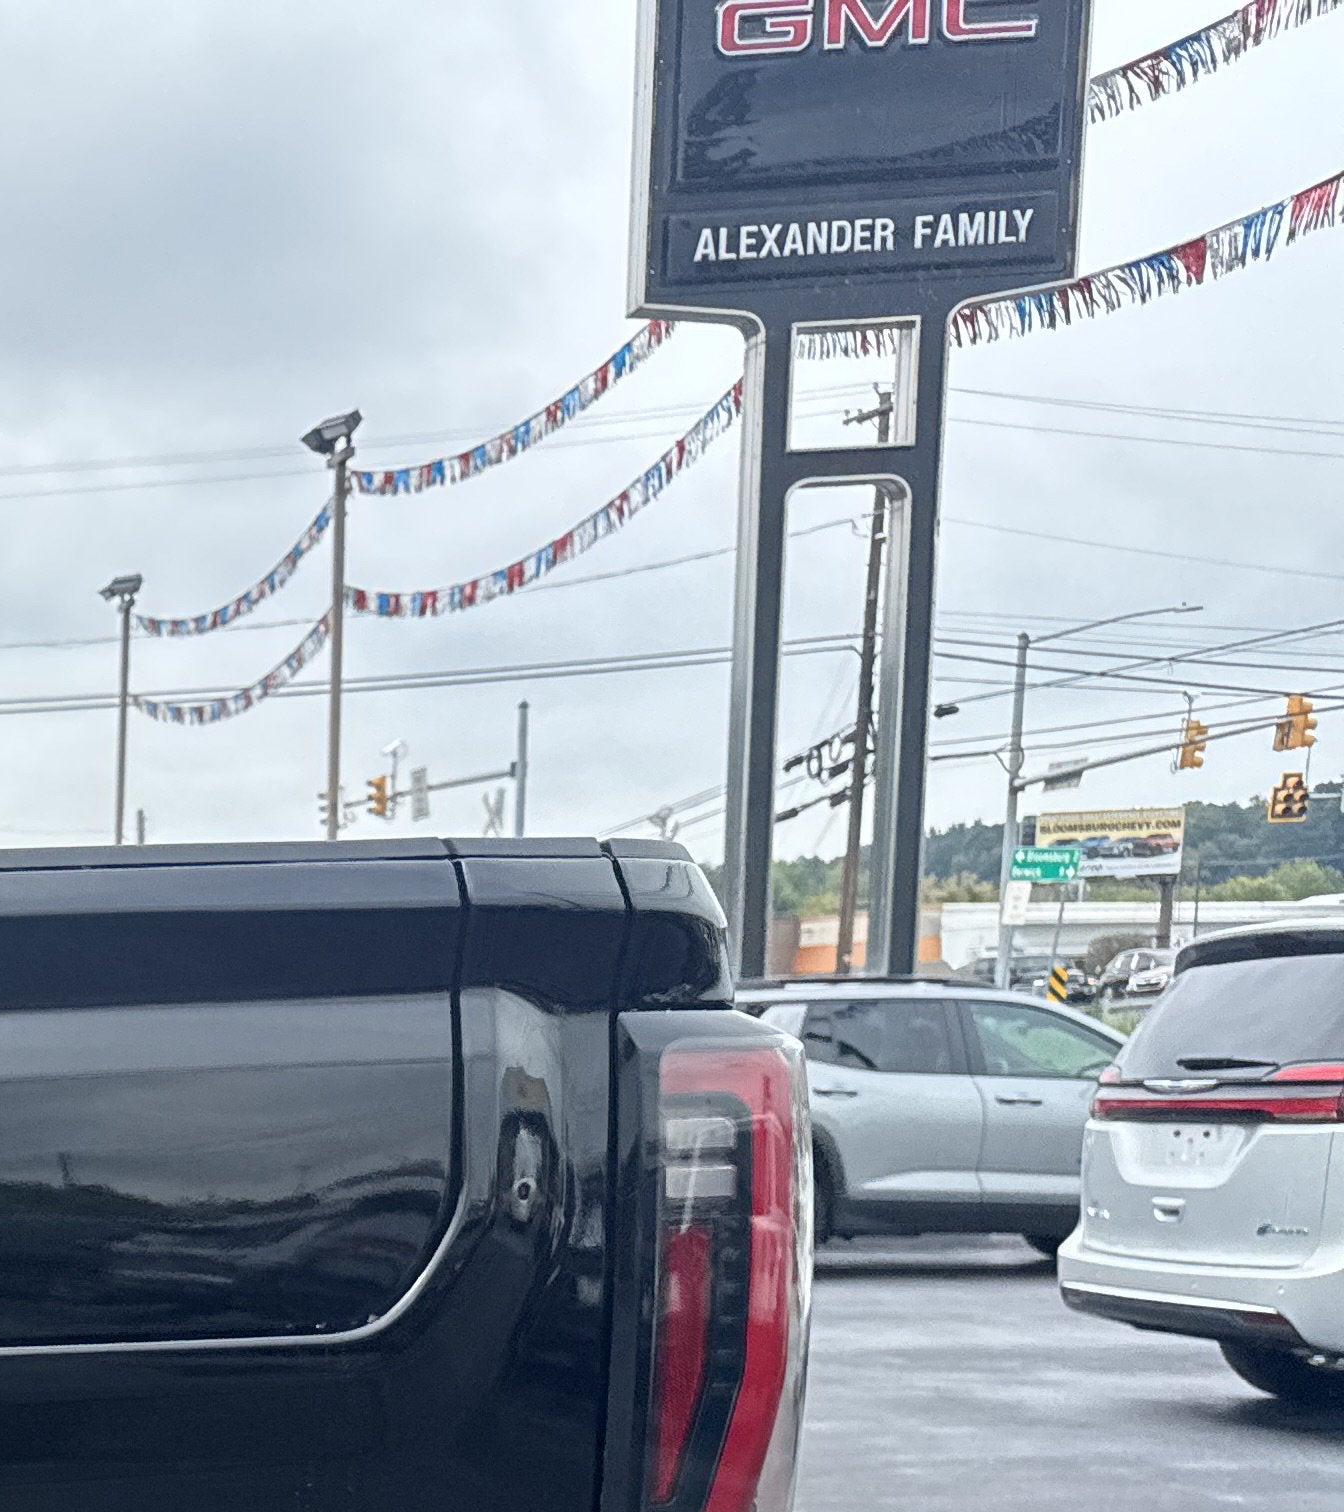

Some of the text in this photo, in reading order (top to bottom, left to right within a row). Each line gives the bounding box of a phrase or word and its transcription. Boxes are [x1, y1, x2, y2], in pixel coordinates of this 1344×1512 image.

[716, 0, 1038, 57] GMC
[693, 208, 1035, 263] ALEXANDER FAMILY
